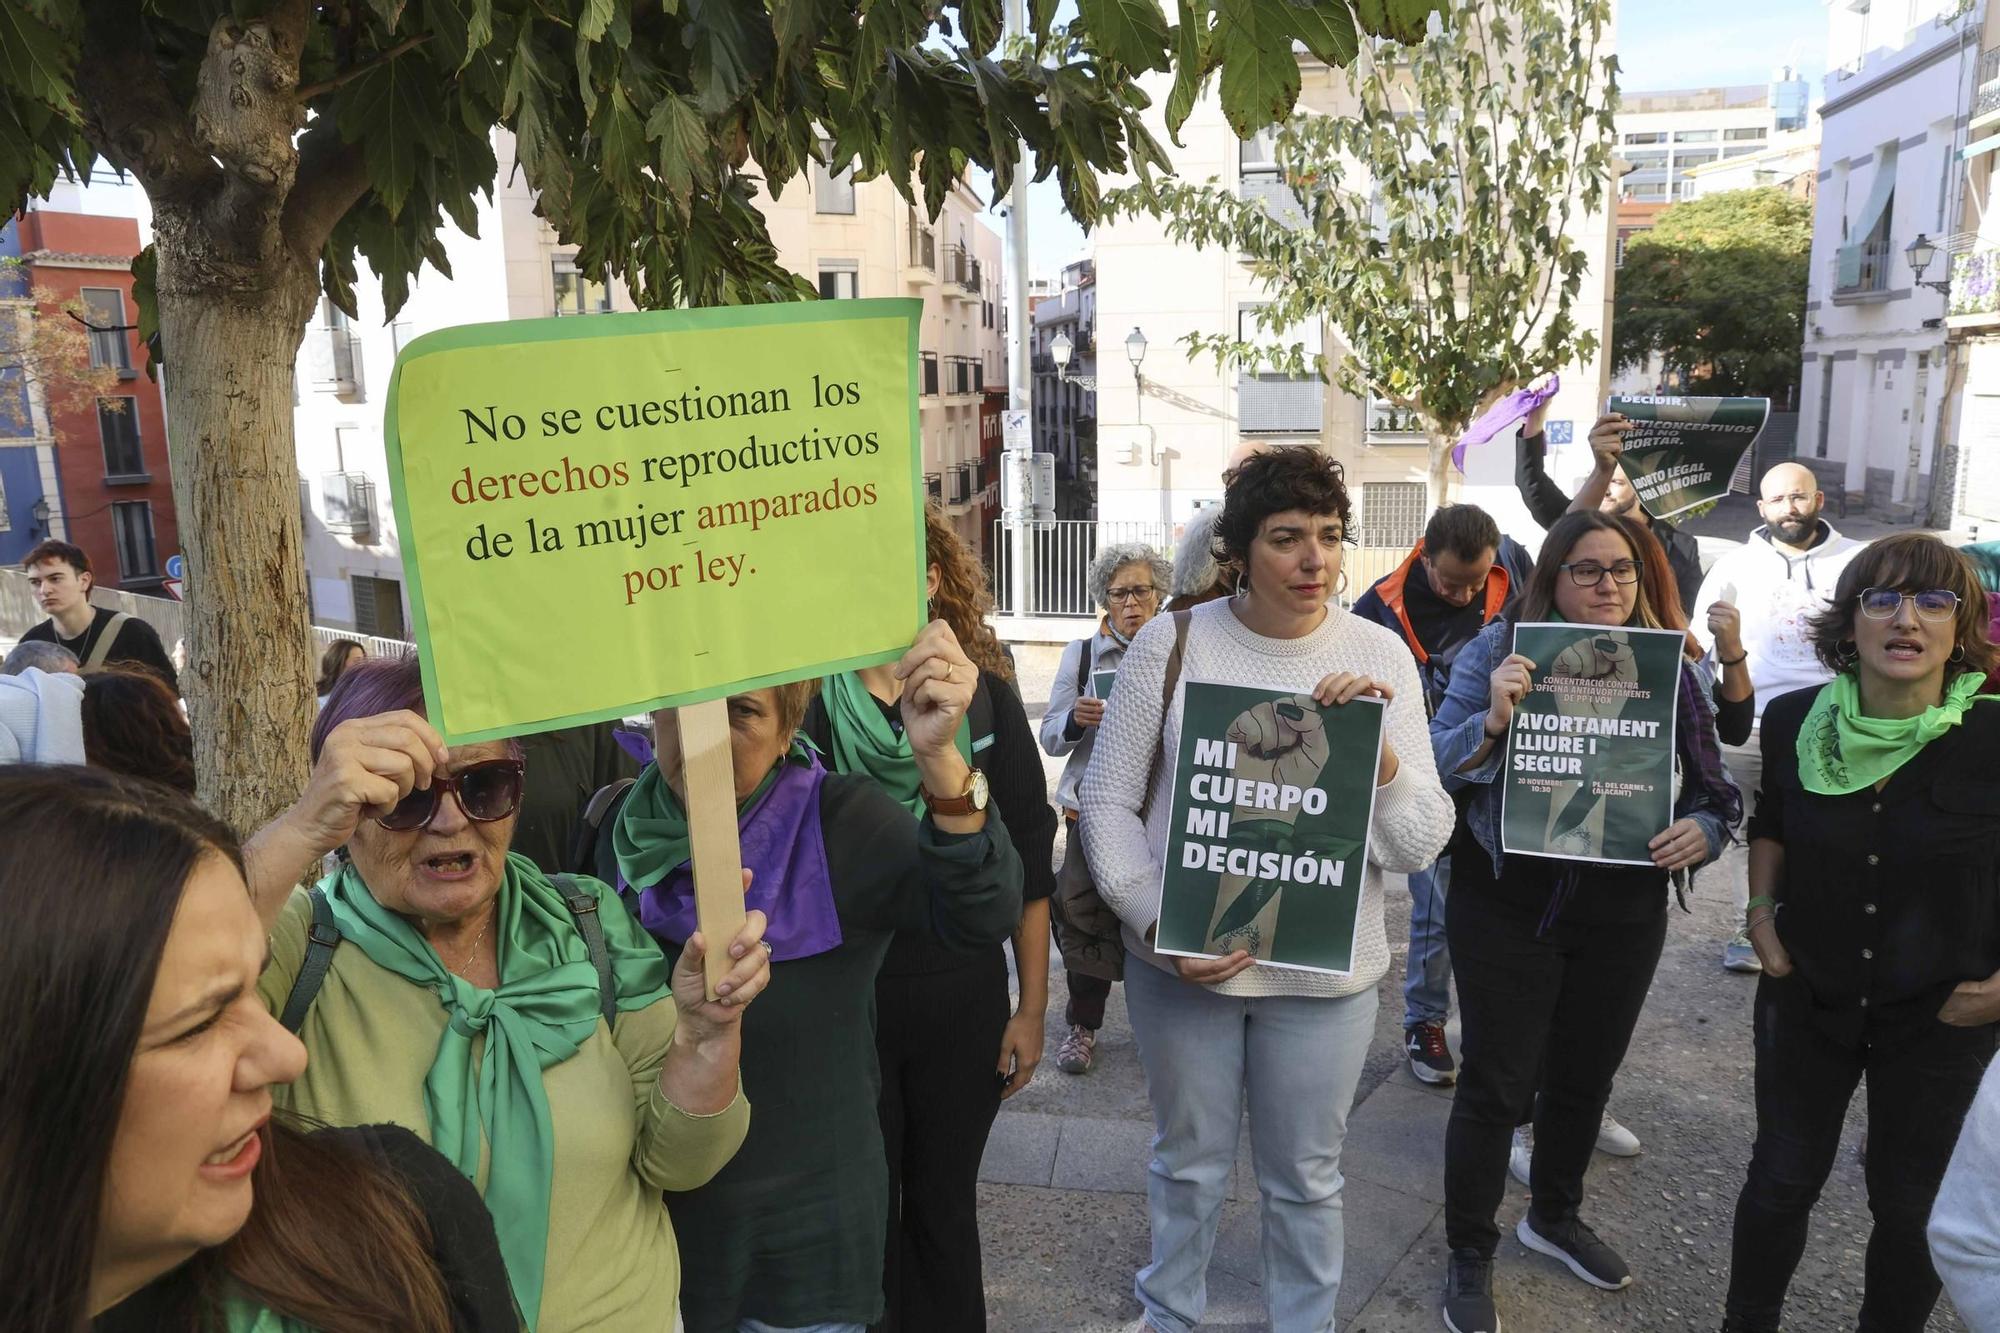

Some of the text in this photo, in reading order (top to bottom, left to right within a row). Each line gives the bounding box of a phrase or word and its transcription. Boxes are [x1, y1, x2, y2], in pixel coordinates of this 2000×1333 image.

[459, 375, 861, 444] No se cuestionan los
[451, 428, 880, 505] derechos reproductivos
[1667, 462, 1705, 479] LEGAL
[1656, 482, 1671, 496] NO
[1672, 472, 1713, 491] MORIR
[466, 478, 878, 561] de la mujer amparados
[622, 549, 757, 606] por ley.
[1543, 676, 1639, 690] CONCENTRACIÓ CONTRA
[1571, 685, 1651, 699] ANTIAVORTAMENTS
[1563, 694, 1574, 702] DE
[1577, 694, 1588, 703] PP
[1595, 696, 1612, 705] VOX
[1516, 712, 1660, 739] AVORTAMENT
[1193, 738, 1238, 770] MI
[1515, 733, 1597, 755] LLIURE I
[1513, 754, 1583, 775] SEGUR
[1517, 777, 1563, 787] 20 NOVEMBRE
[1531, 785, 1552, 793] 10:30
[1592, 788, 1632, 798] (ALACANT)
[1605, 782, 1619, 790] DEL
[1189, 773, 1328, 816] CUERPO
[1185, 807, 1230, 839] MI
[1181, 841, 1345, 887] DECISIÓN
